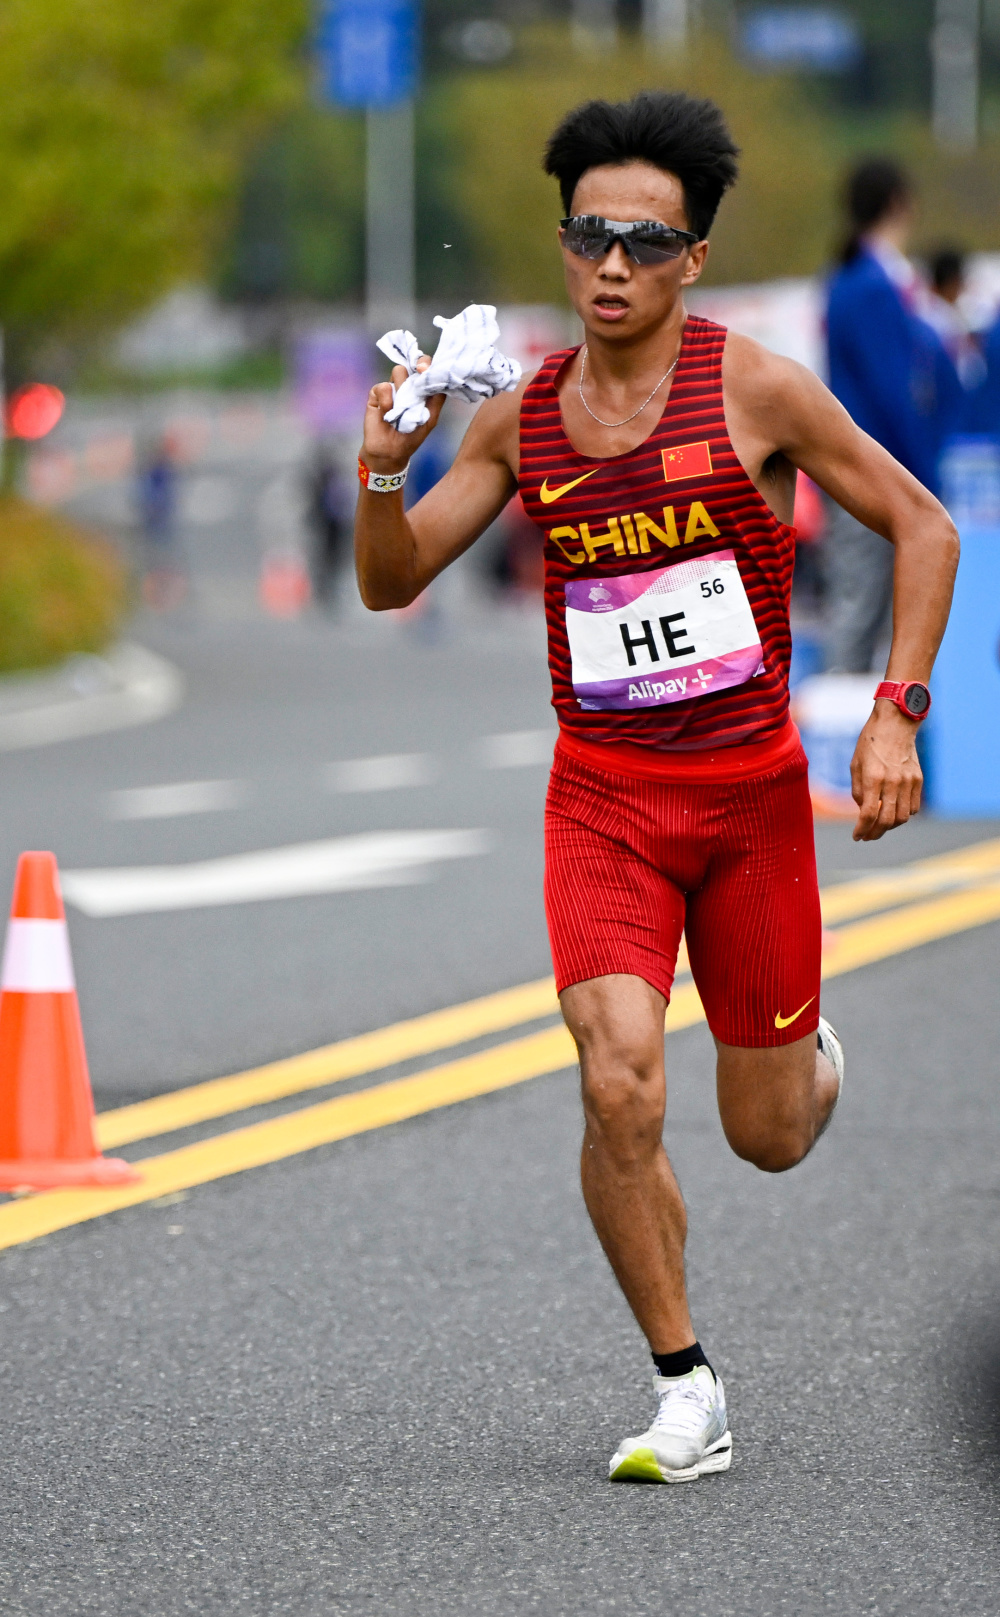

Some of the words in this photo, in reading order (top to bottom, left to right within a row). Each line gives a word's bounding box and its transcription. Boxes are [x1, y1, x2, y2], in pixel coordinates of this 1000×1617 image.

[549, 501, 720, 564] CHINA
[700, 578, 725, 598] 56
[619, 611, 696, 667] HE
[628, 677, 688, 700] Alipay
